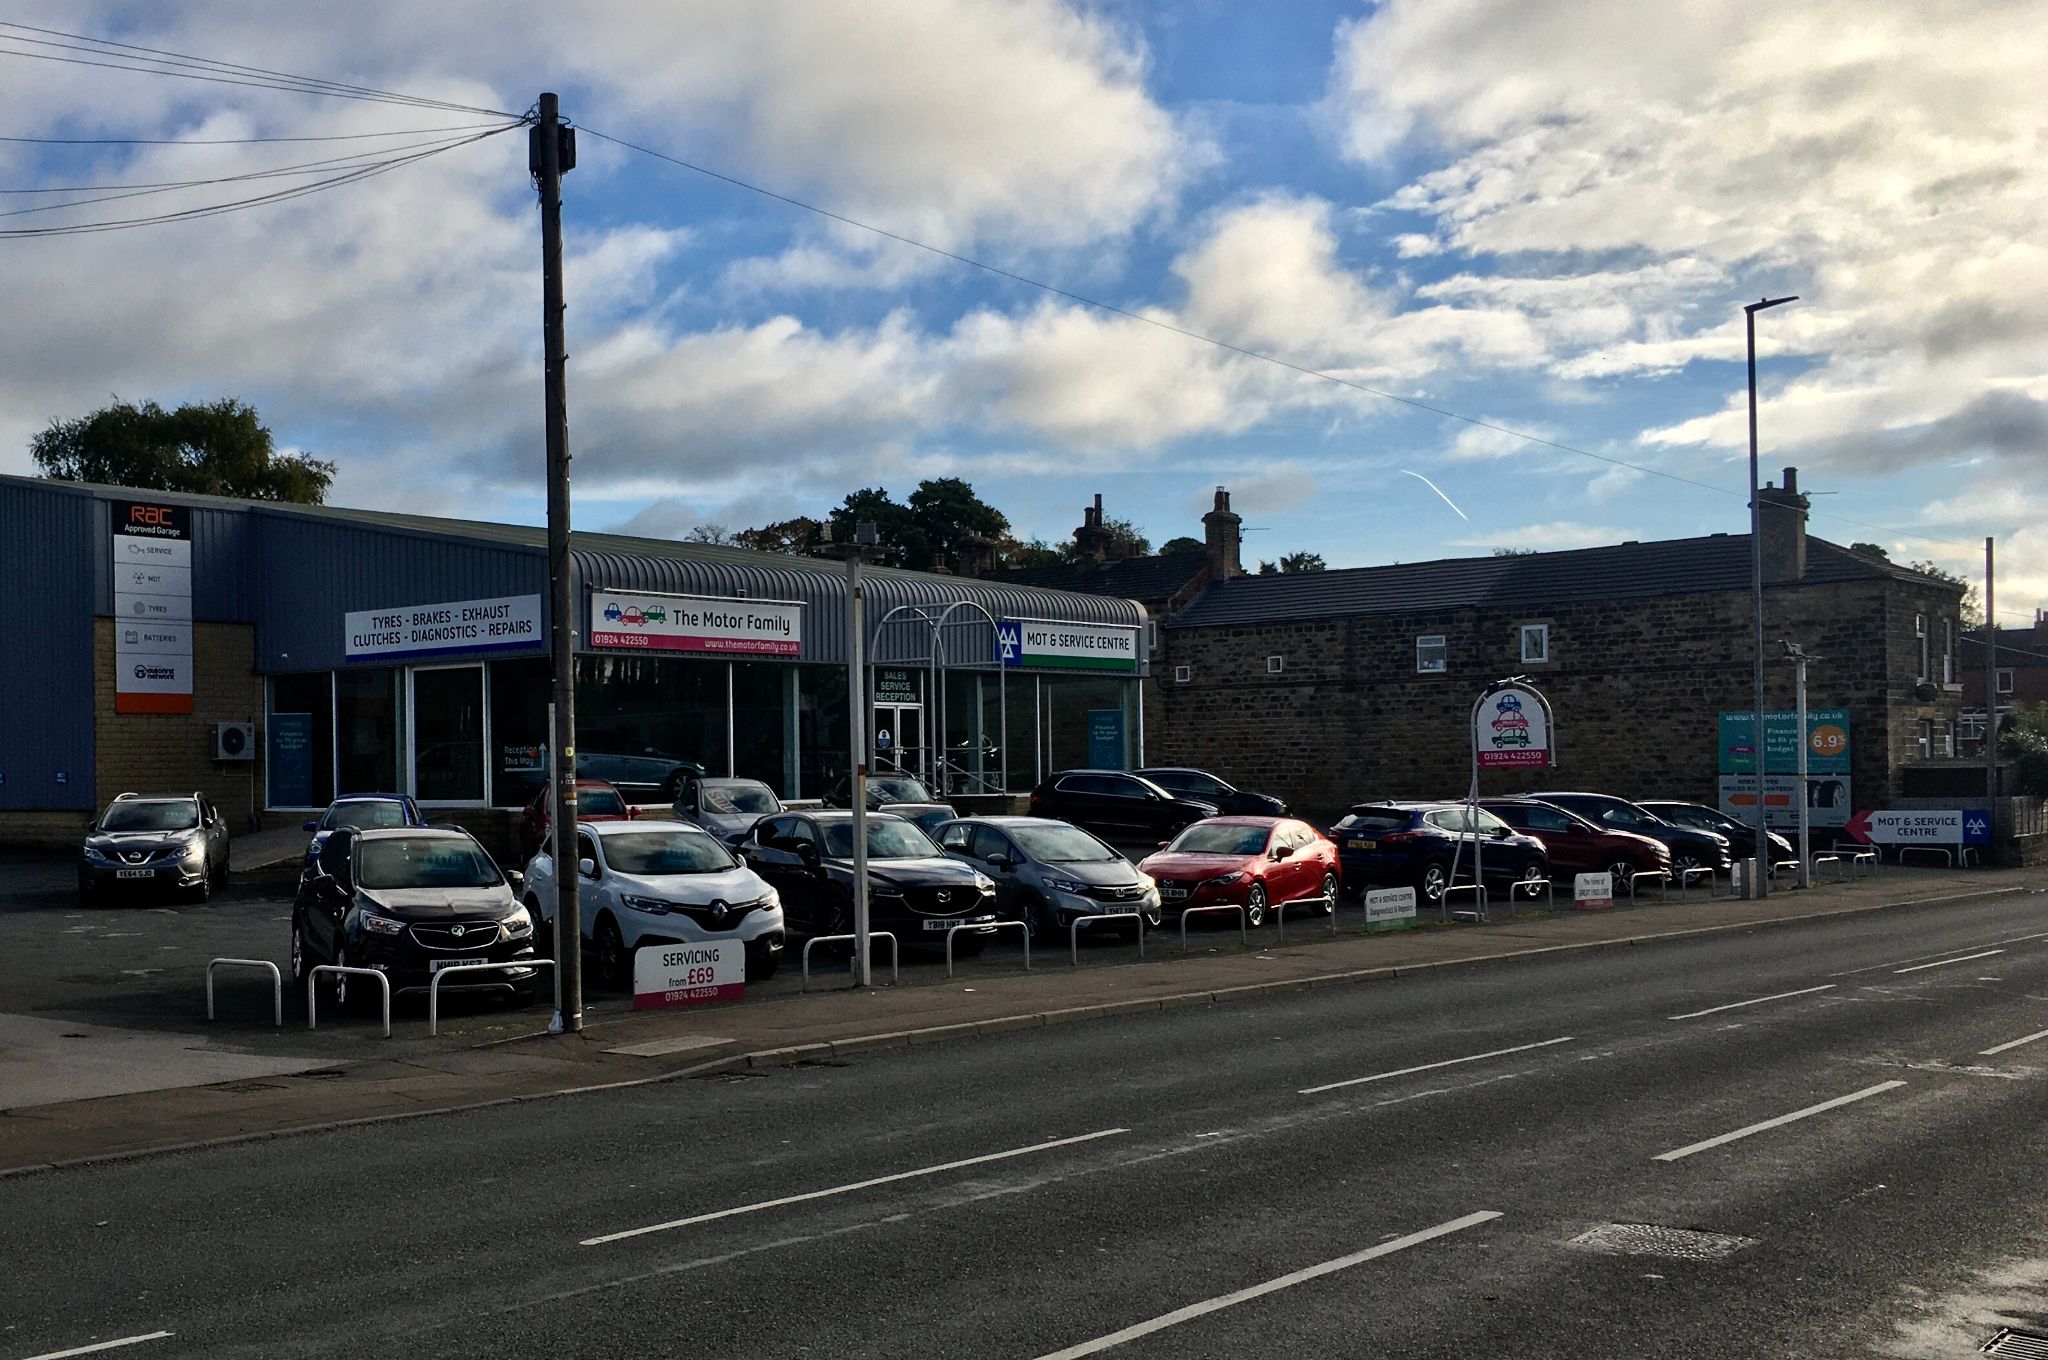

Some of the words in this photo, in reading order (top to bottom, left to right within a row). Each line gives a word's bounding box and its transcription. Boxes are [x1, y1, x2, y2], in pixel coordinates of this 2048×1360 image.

[124, 524, 156, 535] Approved
[157, 526, 181, 537] Garage
[147, 547, 173, 555] SERVICE
[149, 605, 167, 613] TYRES
[372, 615, 402, 629] TYRES
[412, 610, 451, 625] BRAKES
[462, 604, 510, 621] EXHAUST
[673, 610, 699, 626] The
[703, 612, 744, 629] Motor
[748, 614, 790, 635] Family
[144, 634, 176, 642] BATTERIES
[353, 631, 401, 647] CLUTCHES
[412, 624, 477, 642] DIAGNOSTICS
[489, 620, 532, 636] REPAIRS
[594, 635, 619, 645] 01924
[620, 636, 649, 646] 422550
[1027, 632, 1047, 646] MOT
[1050, 634, 1057, 646] &
[1058, 634, 1095, 648] SERVICE
[1097, 636, 1130, 650] CENTRE
[704, 640, 798, 652] www.themotorfamily.co.uk
[883, 671, 907, 680] SALES
[880, 682, 911, 691] SERVICE
[875, 692, 916, 701] RECEPTION
[504, 745, 538, 756] Reception
[1767, 746, 1795, 754] budget
[1484, 752, 1509, 760] 01924
[504, 757, 519, 765] This
[519, 757, 534, 767] Way
[1878, 818, 1901, 826] MOT
[1904, 818, 1910, 826] &
[1914, 818, 1958, 826] SERVICE
[1897, 828, 1938, 836] CENTRE
[663, 949, 719, 967] SERVICING
[669, 978, 687, 987] from
[687, 967, 714, 985] £69
[665, 990, 689, 1002] 01924
[690, 987, 718, 998] 422550
